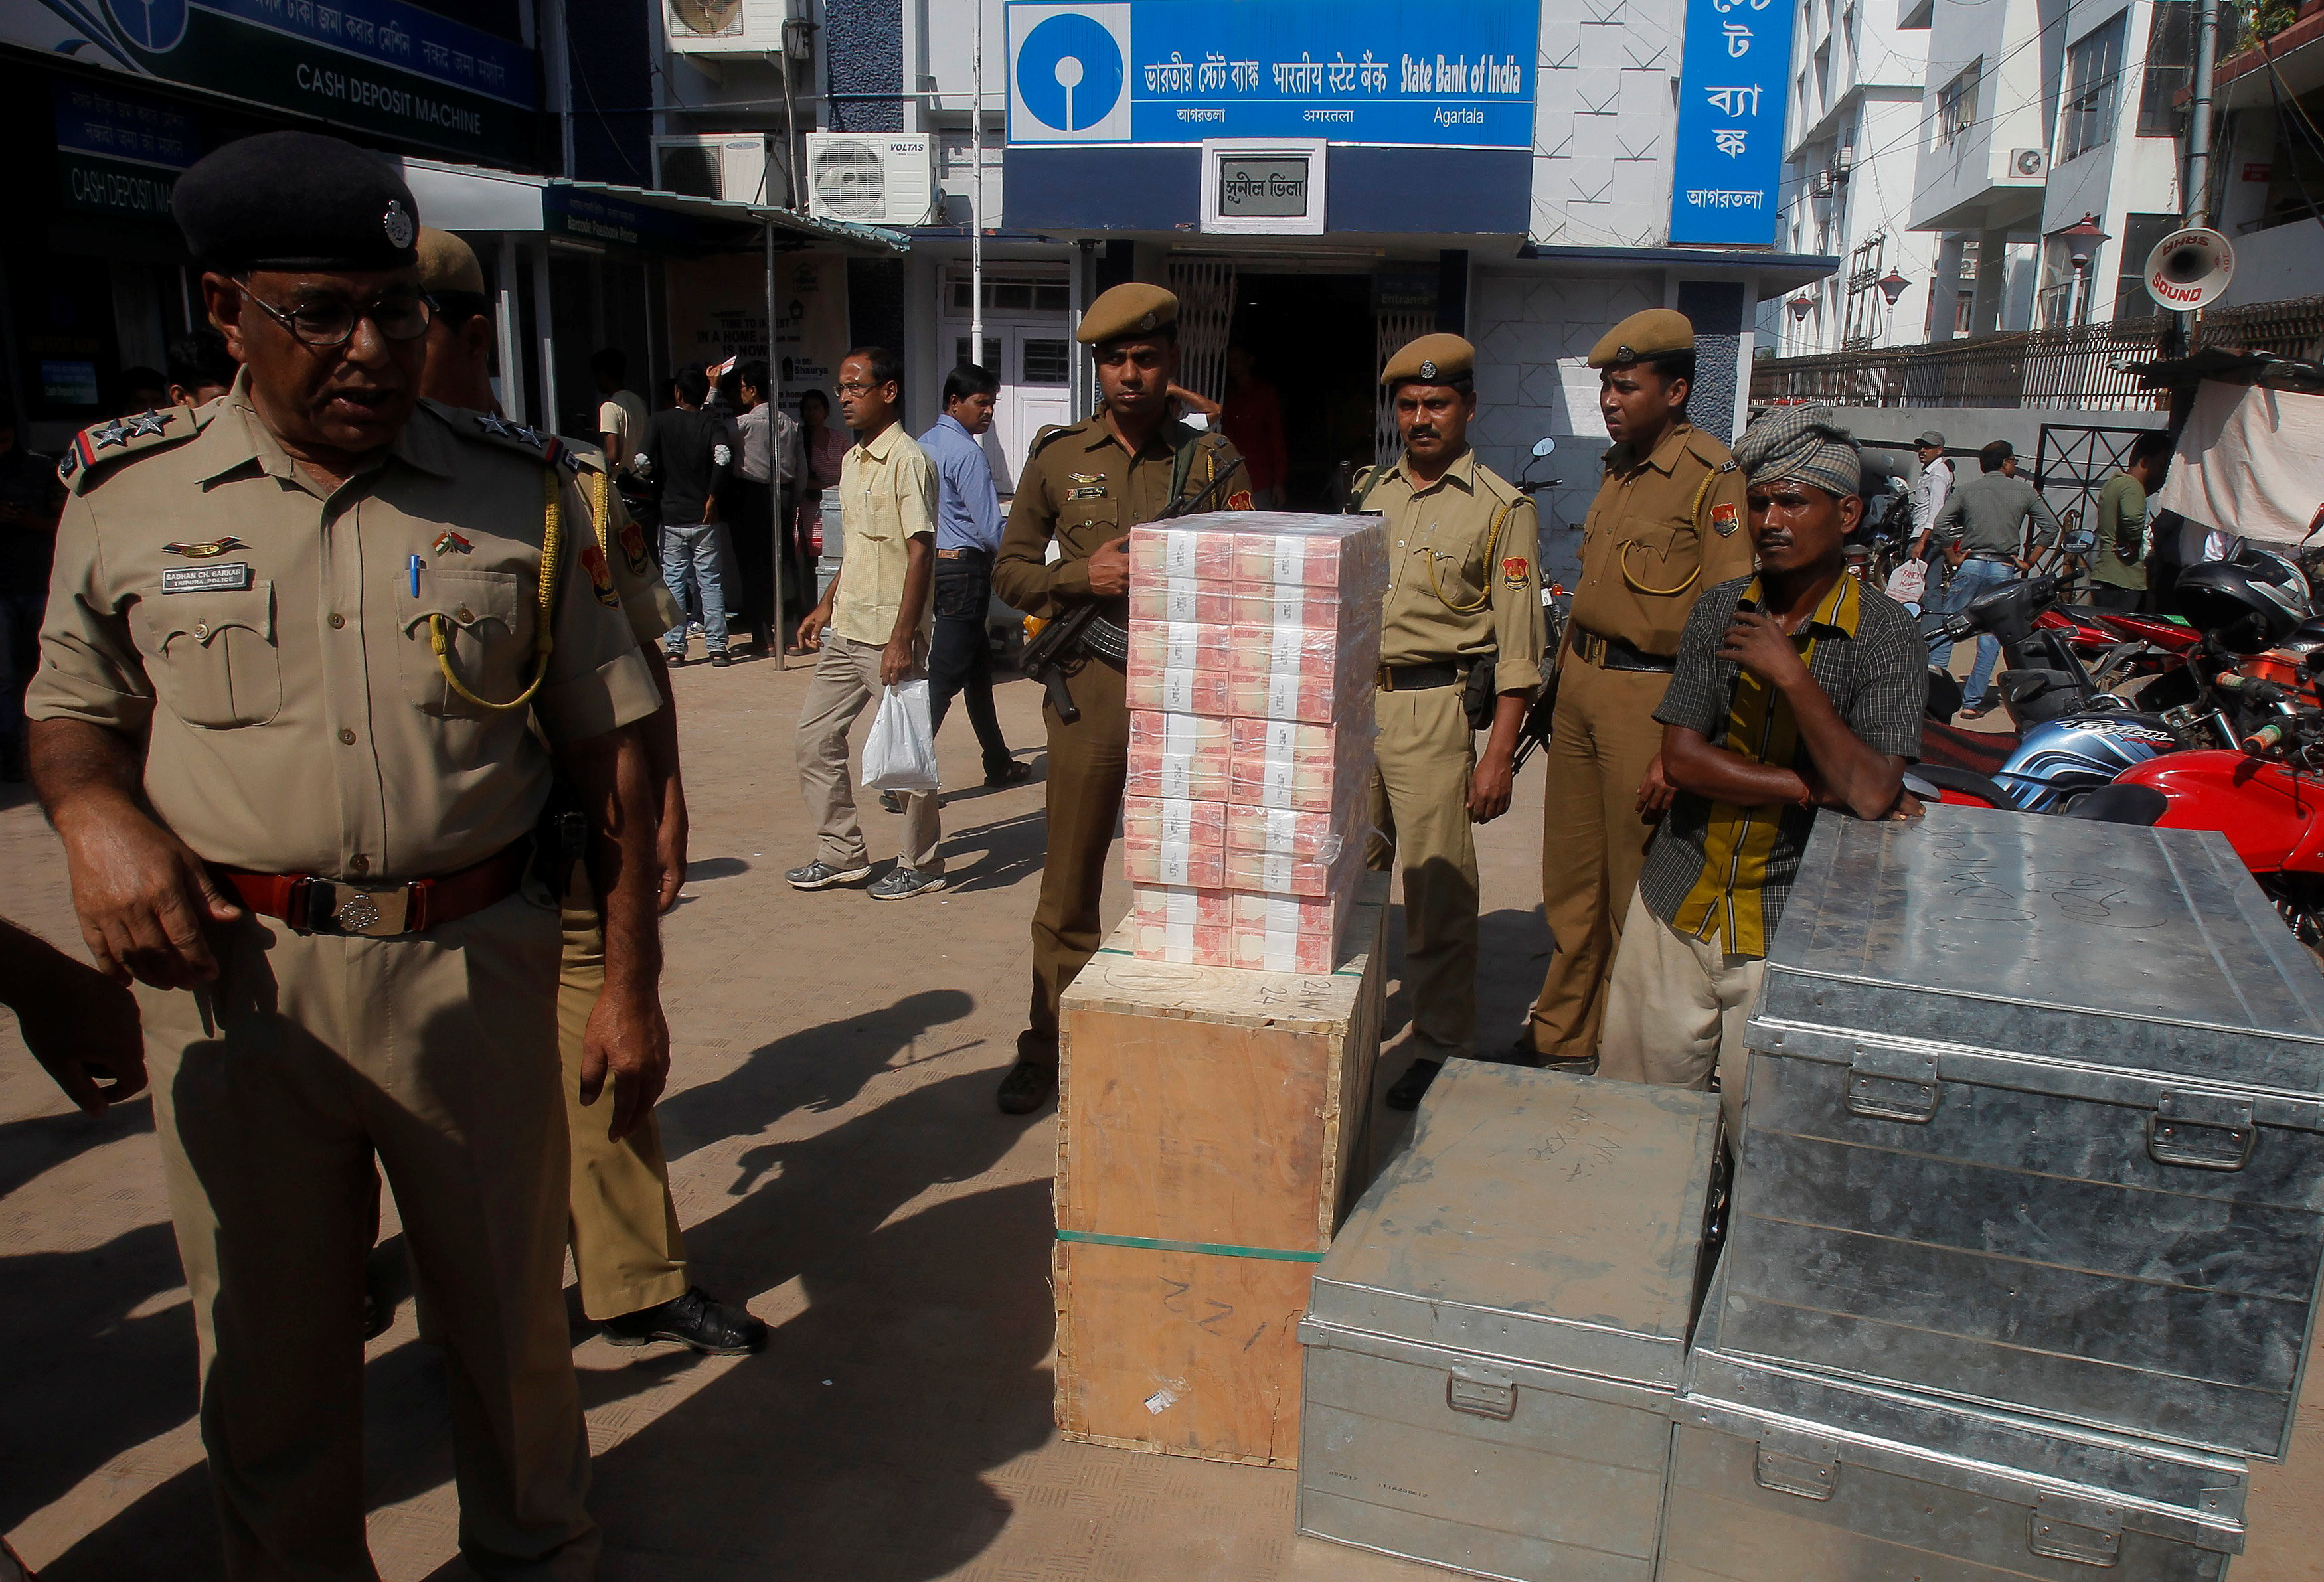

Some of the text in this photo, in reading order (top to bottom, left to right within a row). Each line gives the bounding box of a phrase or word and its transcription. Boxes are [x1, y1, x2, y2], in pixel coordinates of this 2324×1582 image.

[1143, 50, 1260, 94] ভারতীয় স্টেট ব্যাঙ্ক
[1272, 48, 1389, 94] भारतीय स्टेट बैंक
[1400, 53, 1521, 94] State Bank of India
[296, 63, 482, 135] CASH DEPOSIT MACHINE
[1176, 107, 1226, 123] আগরতলা
[1302, 110, 1355, 123] अगरतला
[1433, 106, 1484, 128] Agartala
[890, 143, 924, 152] VOLTAS
[72, 167, 106, 204] CASH
[107, 173, 152, 210] DEPOSIT
[1268, 173, 1305, 197] ভিলা
[1685, 189, 1764, 210] আগরতলা
[2152, 271, 2202, 302] SOUND
[721, 318, 789, 328] TIME TO INEST
[712, 331, 720, 343] A
[723, 331, 757, 343] HOME
[738, 345, 767, 356] NOW
[794, 365, 829, 376] Shaurya
[166, 572, 197, 581] SADHAN
[212, 568, 241, 578] SARKAR
